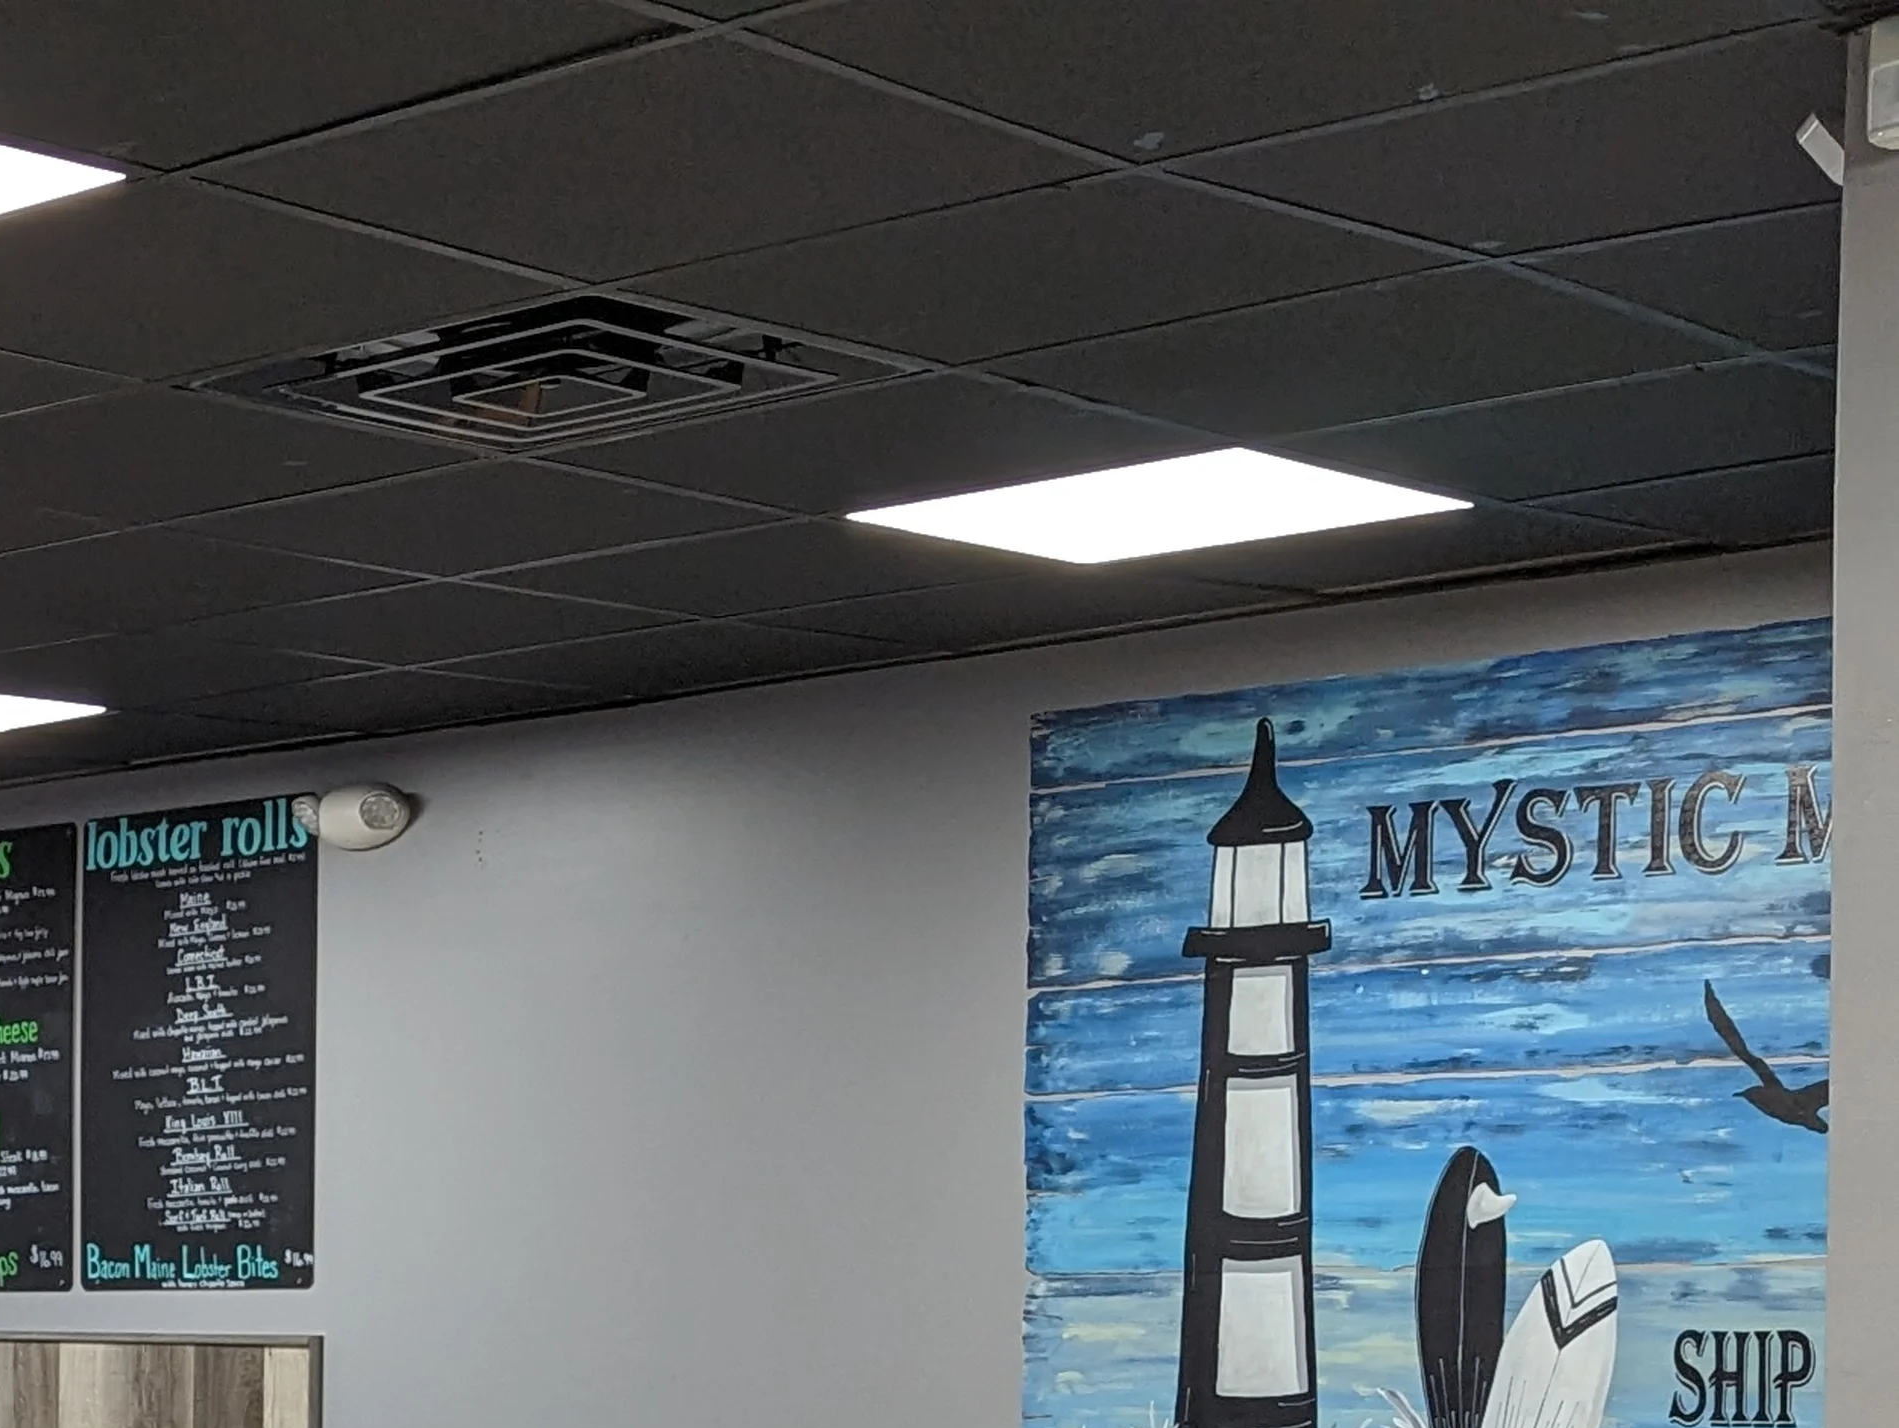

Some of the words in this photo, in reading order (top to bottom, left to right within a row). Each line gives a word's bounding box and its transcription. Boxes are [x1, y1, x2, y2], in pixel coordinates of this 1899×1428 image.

[86, 818, 207, 871] lobster
[220, 798, 308, 857] rolls
[1360, 772, 1747, 899] MYSTIC
[180, 892, 211, 907] Maine
[169, 923, 189, 935] New
[194, 913, 228, 933] England
[176, 1008, 198, 1023] Deep
[186, 1074, 224, 1093] BLT
[165, 1116, 186, 1133] King
[191, 1113, 216, 1128] Louis
[168, 1179, 205, 1195] Italian
[210, 1176, 231, 1191] Roll
[30, 1244, 64, 1268] $16.99
[87, 1243, 130, 1279] Bacon
[134, 1244, 175, 1280] Maine
[182, 1245, 232, 1280] Lobster
[237, 1244, 279, 1279] Bites
[285, 1249, 314, 1267] $16.99
[1668, 1329, 1815, 1428] SHIP
